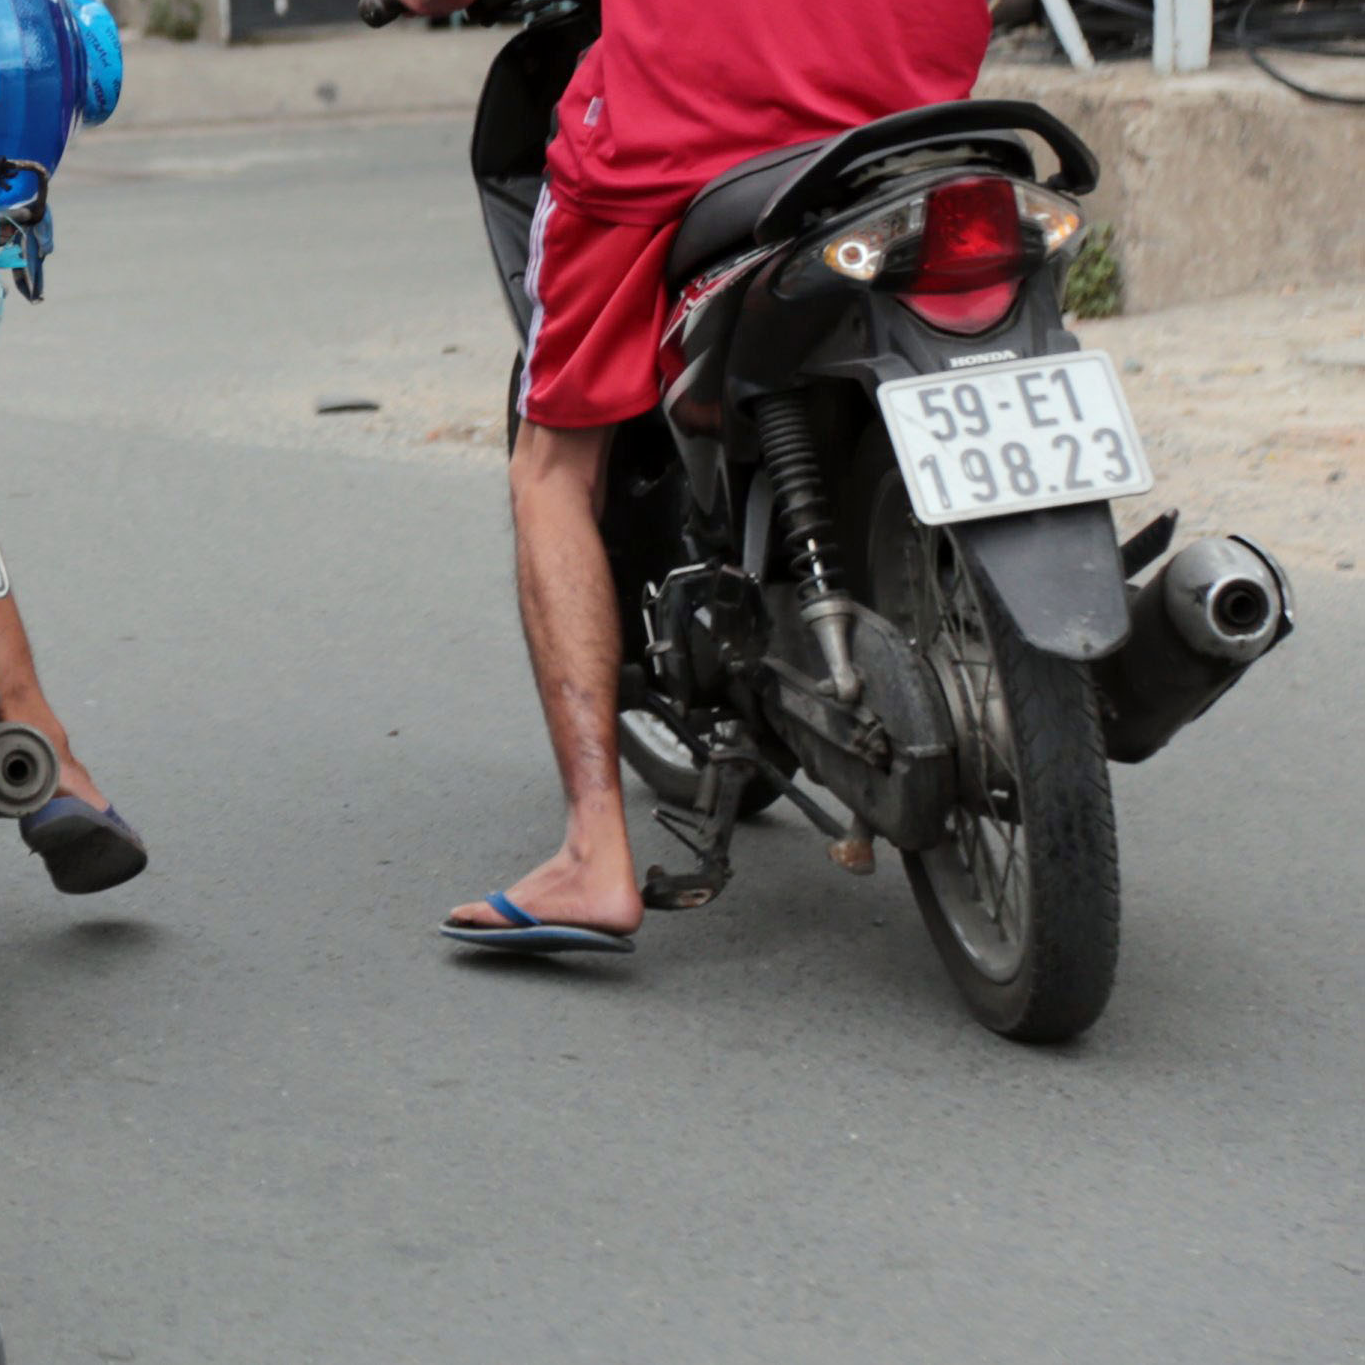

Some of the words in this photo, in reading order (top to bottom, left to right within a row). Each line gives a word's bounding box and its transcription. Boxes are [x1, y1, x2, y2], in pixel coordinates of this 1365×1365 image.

[949, 350, 1017, 368] HONDA
[917, 368, 1085, 443] 59-E1
[918, 427, 1132, 511] 198.23
